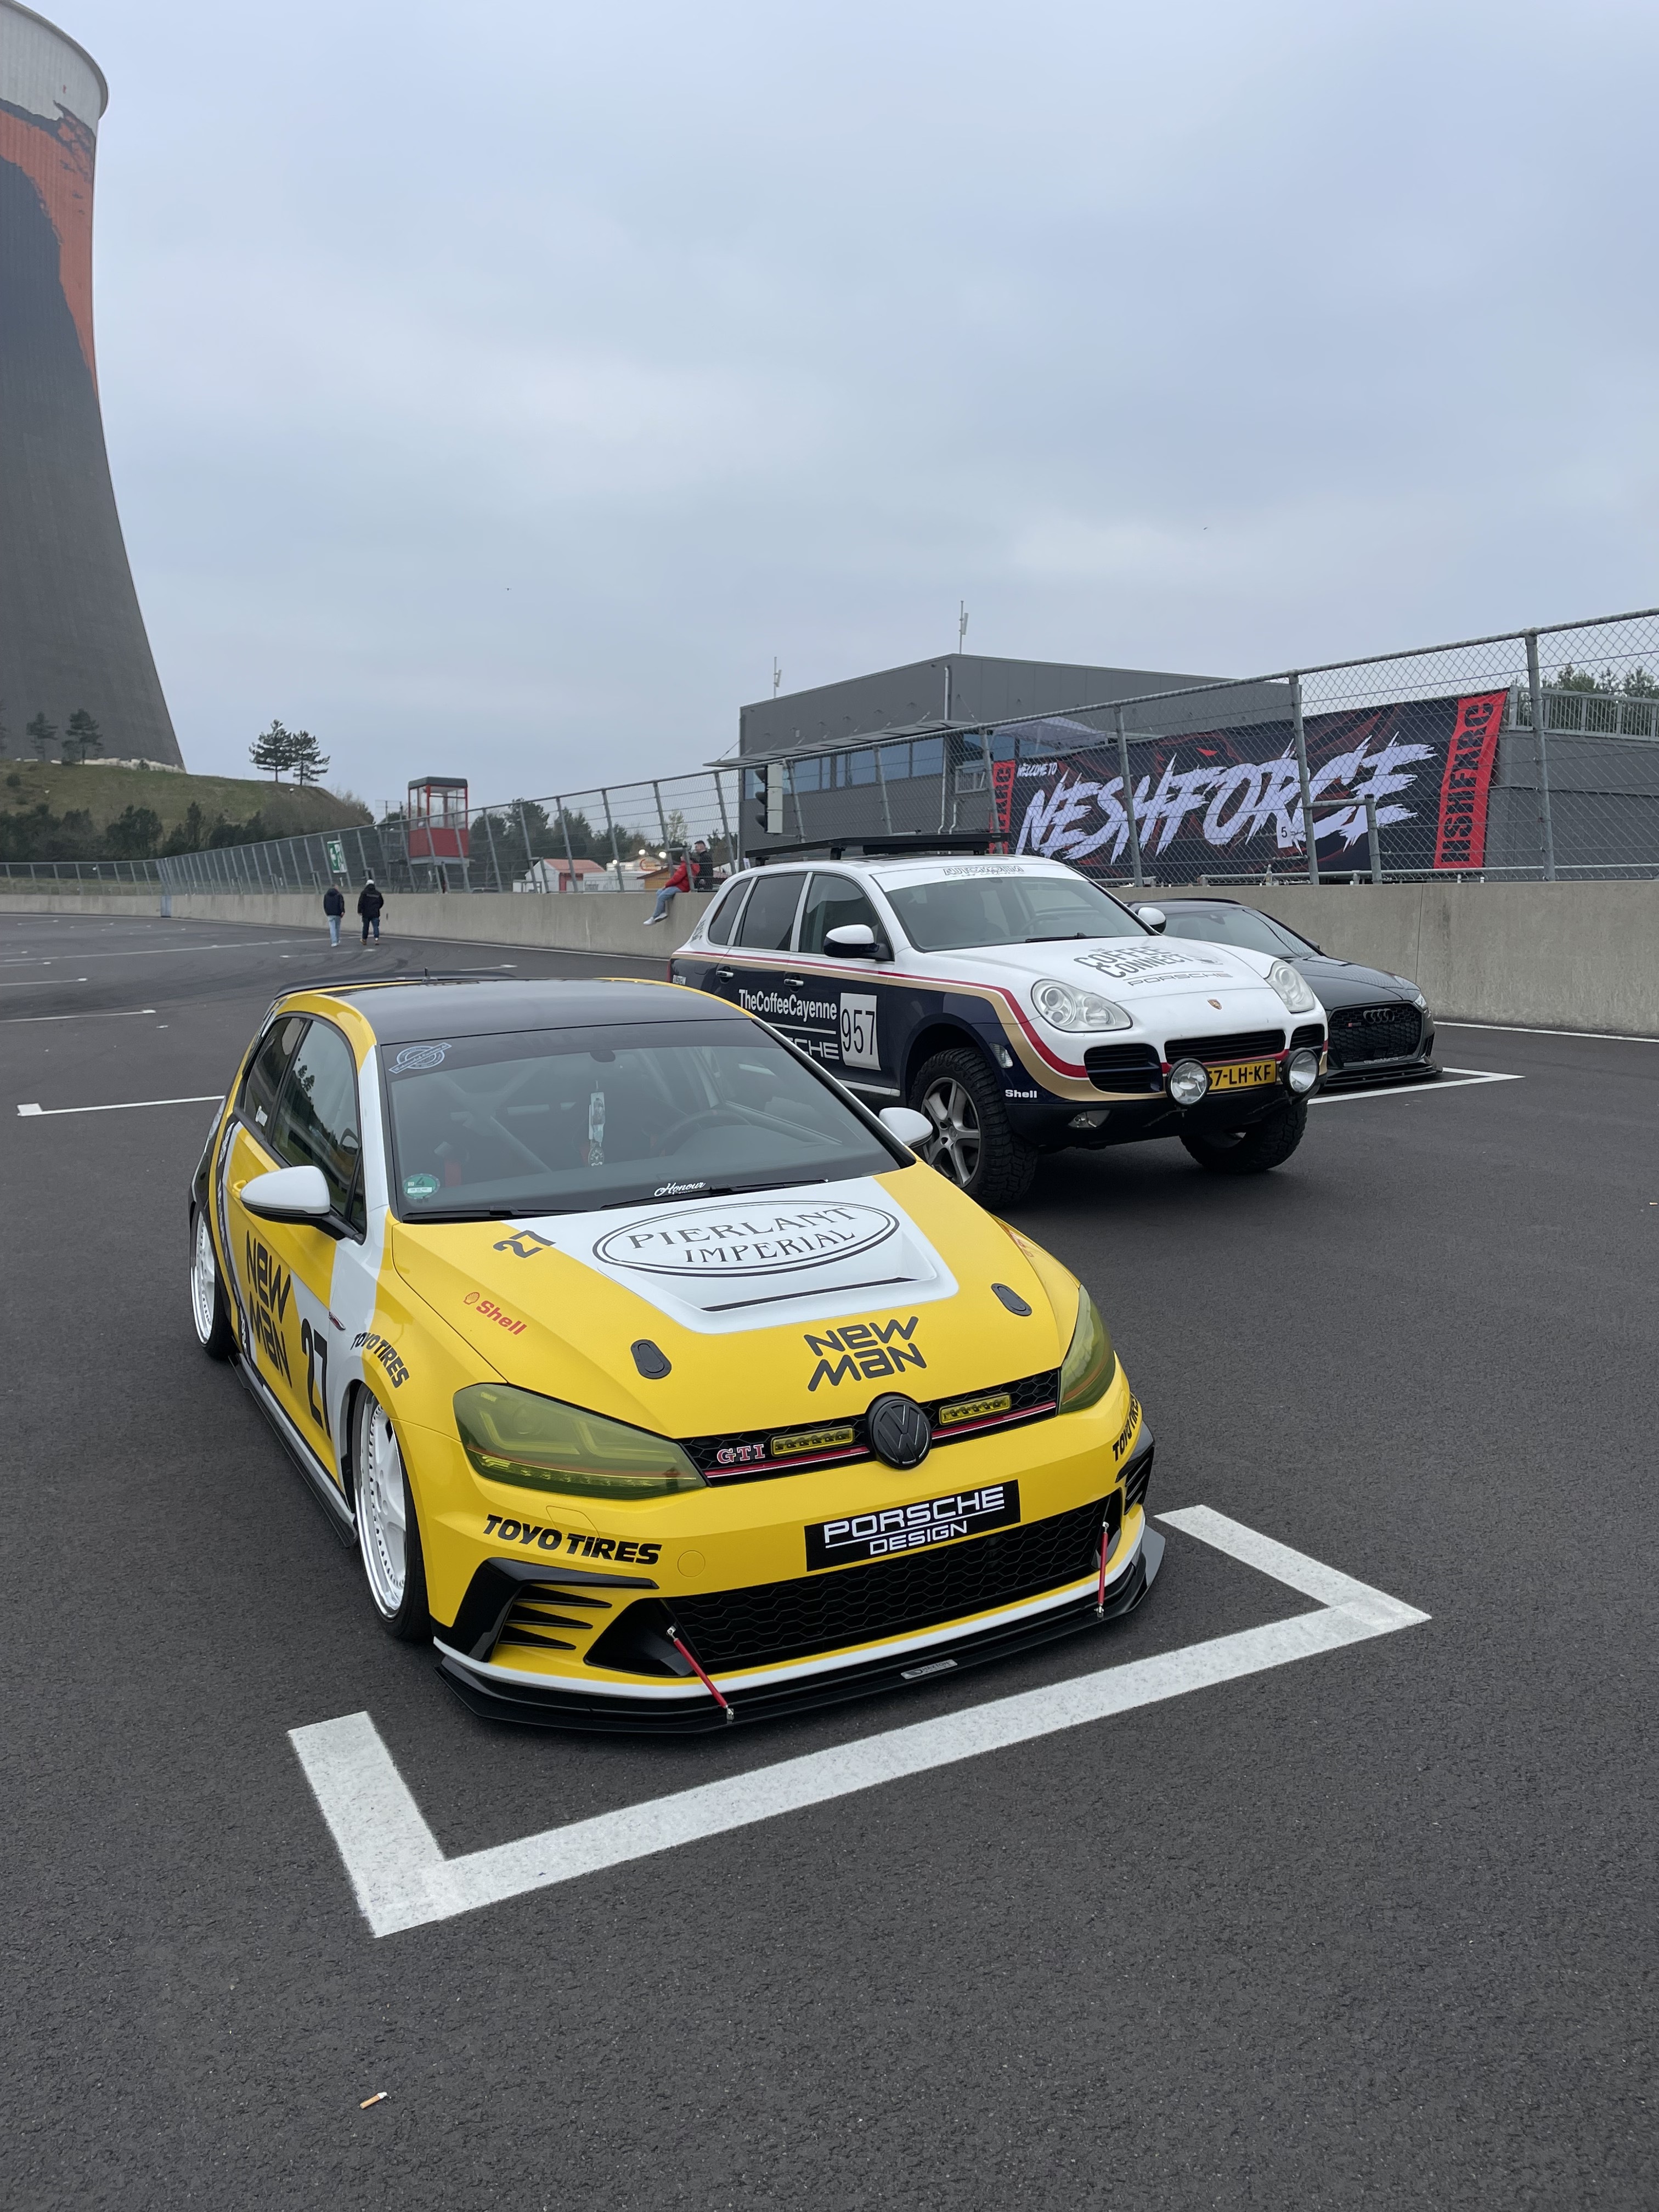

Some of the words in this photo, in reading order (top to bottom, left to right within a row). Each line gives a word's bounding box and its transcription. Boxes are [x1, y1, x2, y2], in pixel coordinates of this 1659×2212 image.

[1048, 761, 1058, 776] TO
[1281, 826, 1288, 838] 5
[1074, 946, 1171, 967] COFFEE
[1096, 953, 1193, 978] CONNECT
[1127, 973, 1233, 986] PORSCHE
[739, 989, 837, 1022] TheCoffeeCayenne
[842, 1008, 876, 1056] 957
[1005, 1090, 1037, 1098] Shell
[416, 1177, 425, 1186] 4
[654, 1182, 706, 1197] Honour
[627, 1207, 857, 1250] PIERLANT
[493, 1230, 556, 1259] 27
[684, 1229, 855, 1263] IMPERIAL
[476, 1300, 527, 1335] Shell
[350, 1332, 381, 1351] TOYO
[373, 1339, 410, 1389] TIRES
[301, 1318, 332, 1453] 27
[717, 1443, 765, 1464] GTI
[823, 1486, 1005, 1543] PORSCHE
[483, 1514, 562, 1550] TOYO
[566, 1533, 662, 1565] TIRES
[870, 1520, 967, 1555] DESIGN
